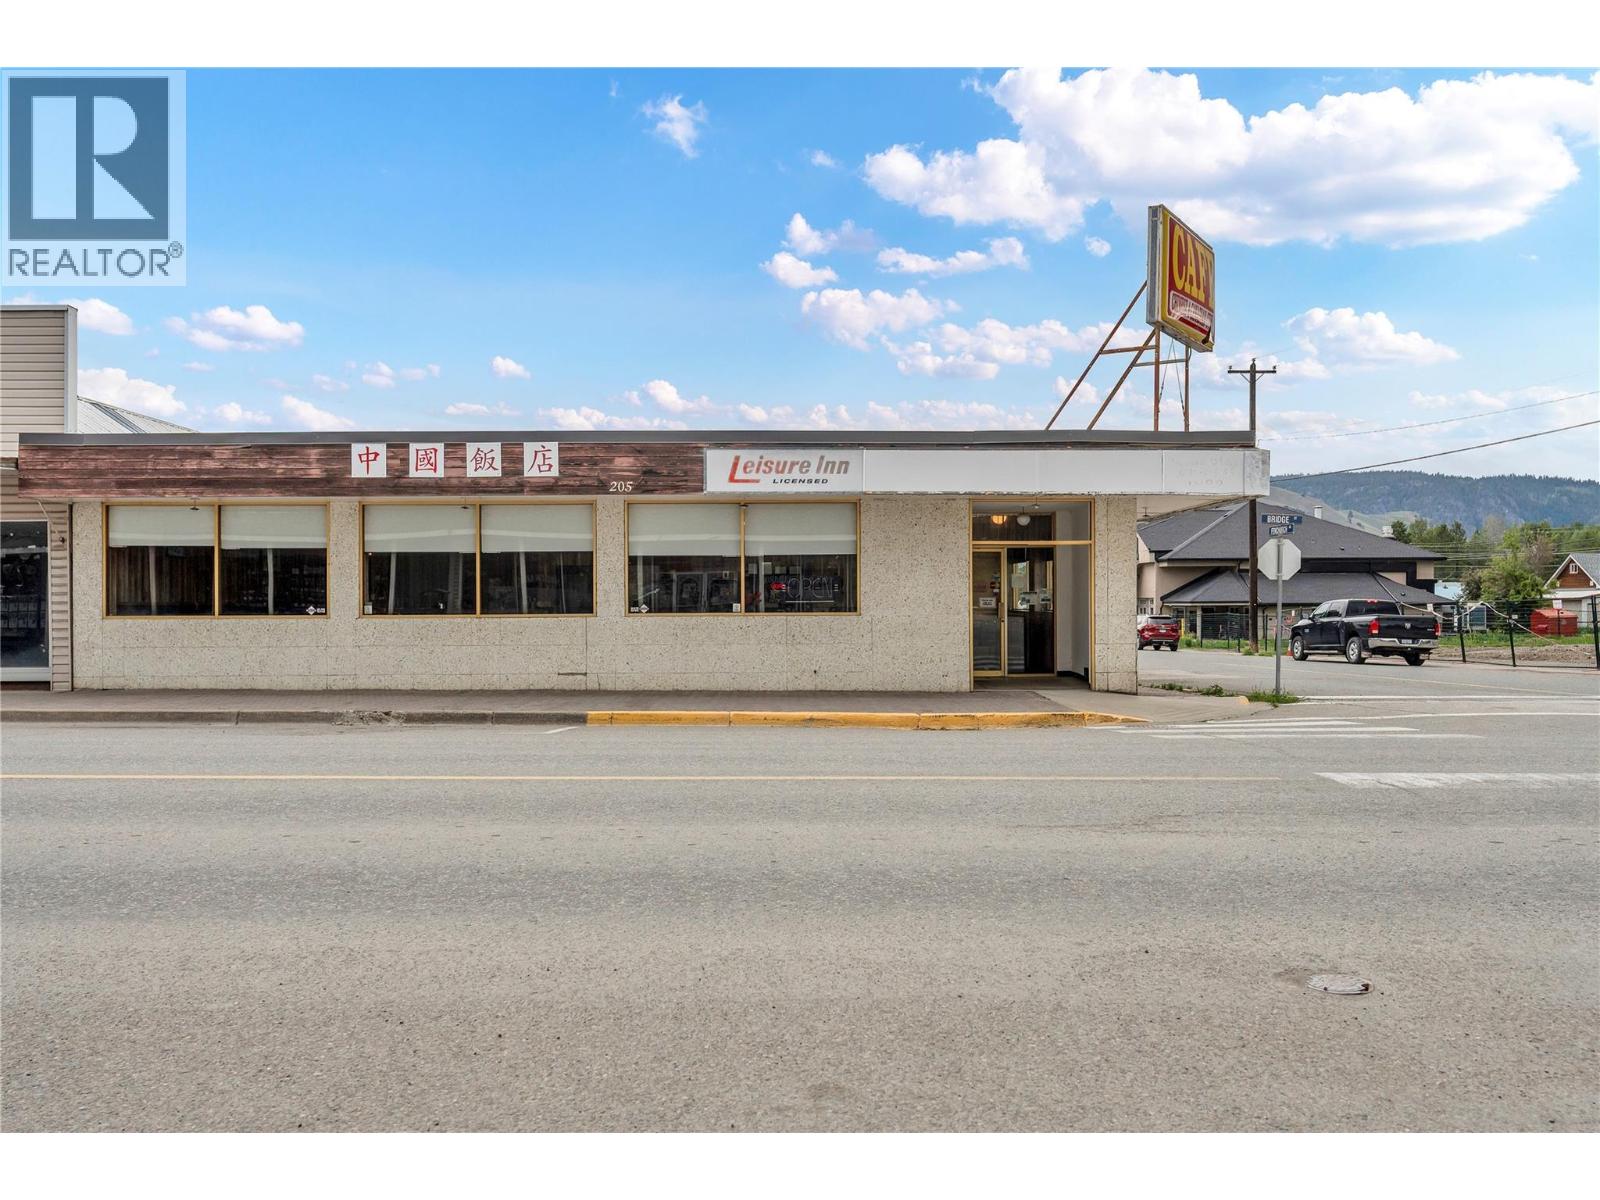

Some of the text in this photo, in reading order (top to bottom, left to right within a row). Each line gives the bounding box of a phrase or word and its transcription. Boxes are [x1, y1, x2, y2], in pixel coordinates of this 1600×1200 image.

[358, 445, 554, 474] 中國飯店
[728, 455, 850, 484] Leisure Inn
[608, 480, 634, 493] 205
[1266, 515, 1290, 524] BRIDGE
[787, 576, 833, 599] OPEN
